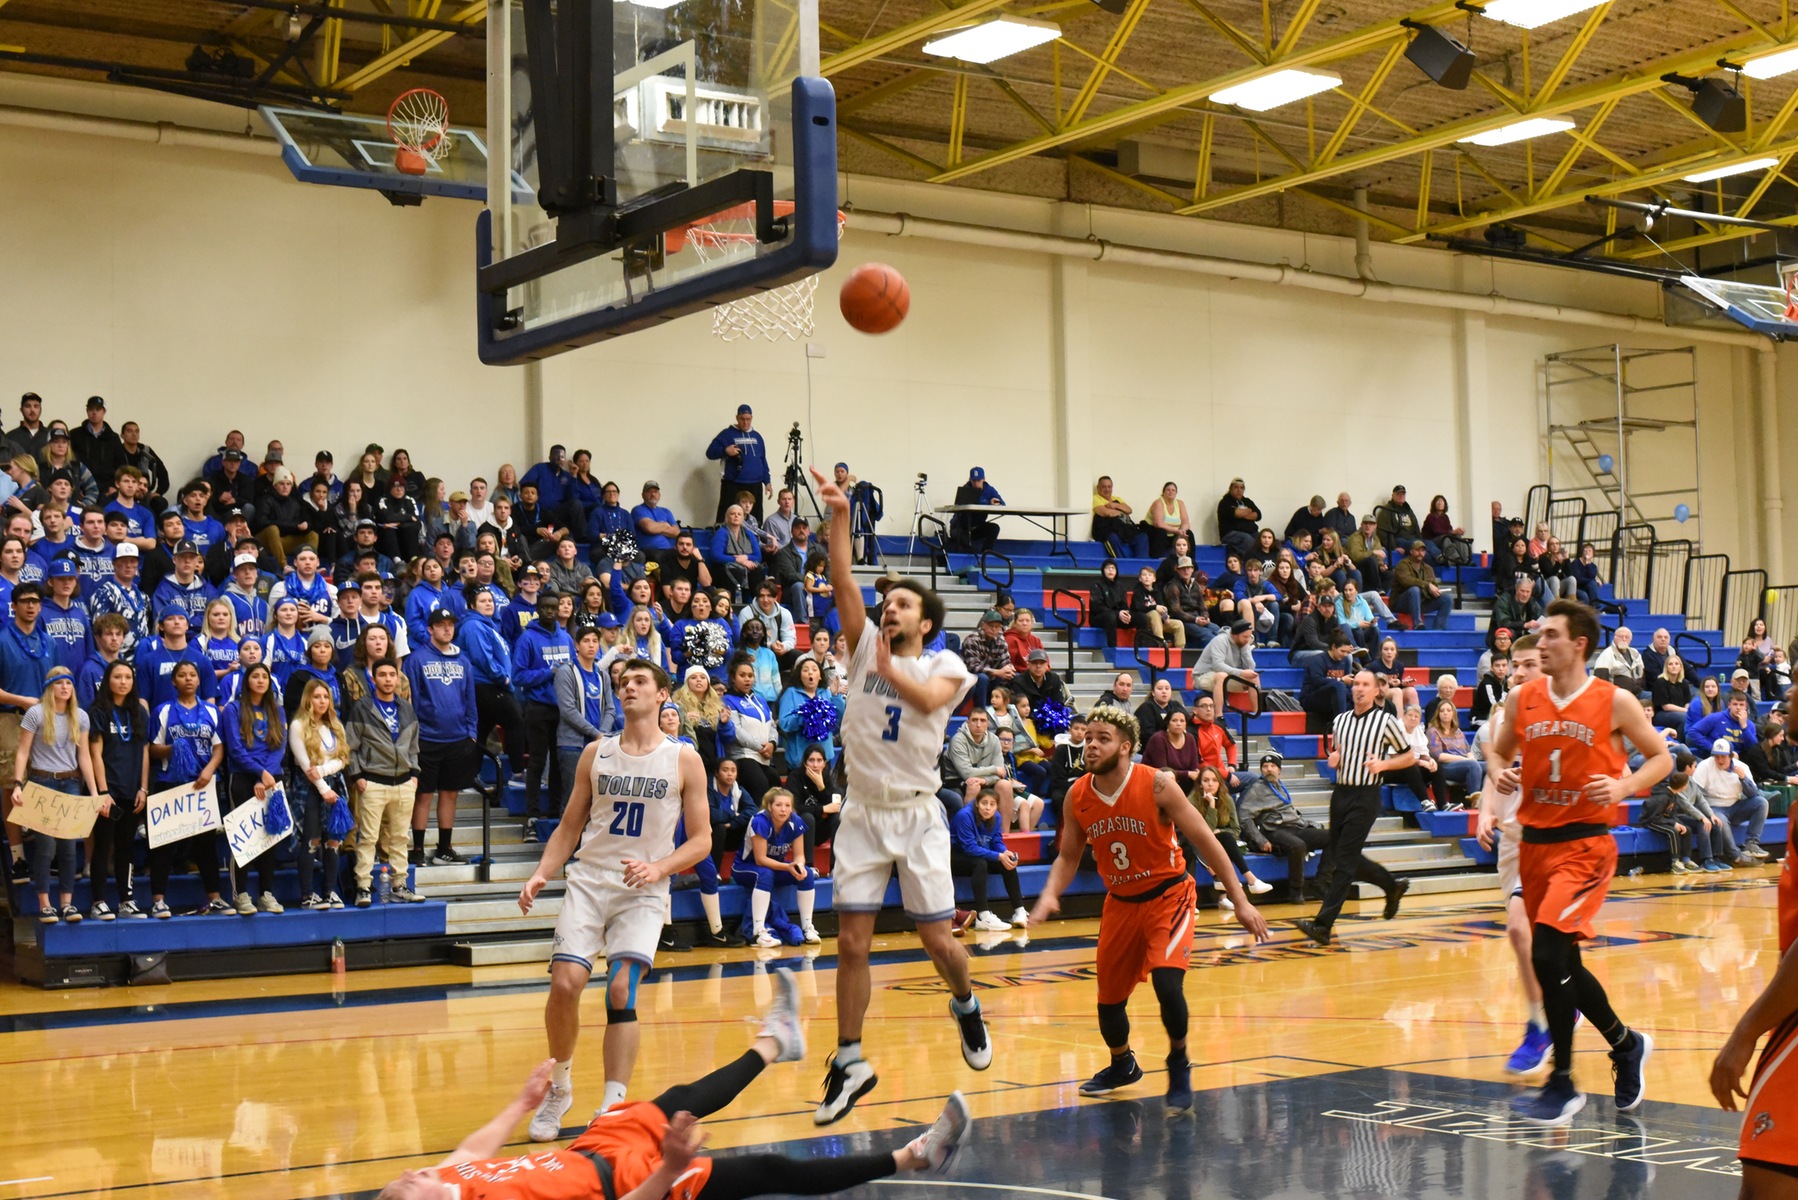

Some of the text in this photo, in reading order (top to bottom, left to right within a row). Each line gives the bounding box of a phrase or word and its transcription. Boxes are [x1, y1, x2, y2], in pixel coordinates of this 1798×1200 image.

[63, 562, 71, 572] B
[881, 705, 902, 743] 3
[1525, 720, 1595, 747] TREASURE
[1549, 748, 1562, 783] 1
[597, 774, 669, 799] WOLVES
[151, 791, 206, 826] DANTE
[203, 809, 215, 827] 2
[608, 801, 645, 837] 20
[1086, 816, 1147, 841] TREASURE
[1110, 841, 1130, 871] 3
